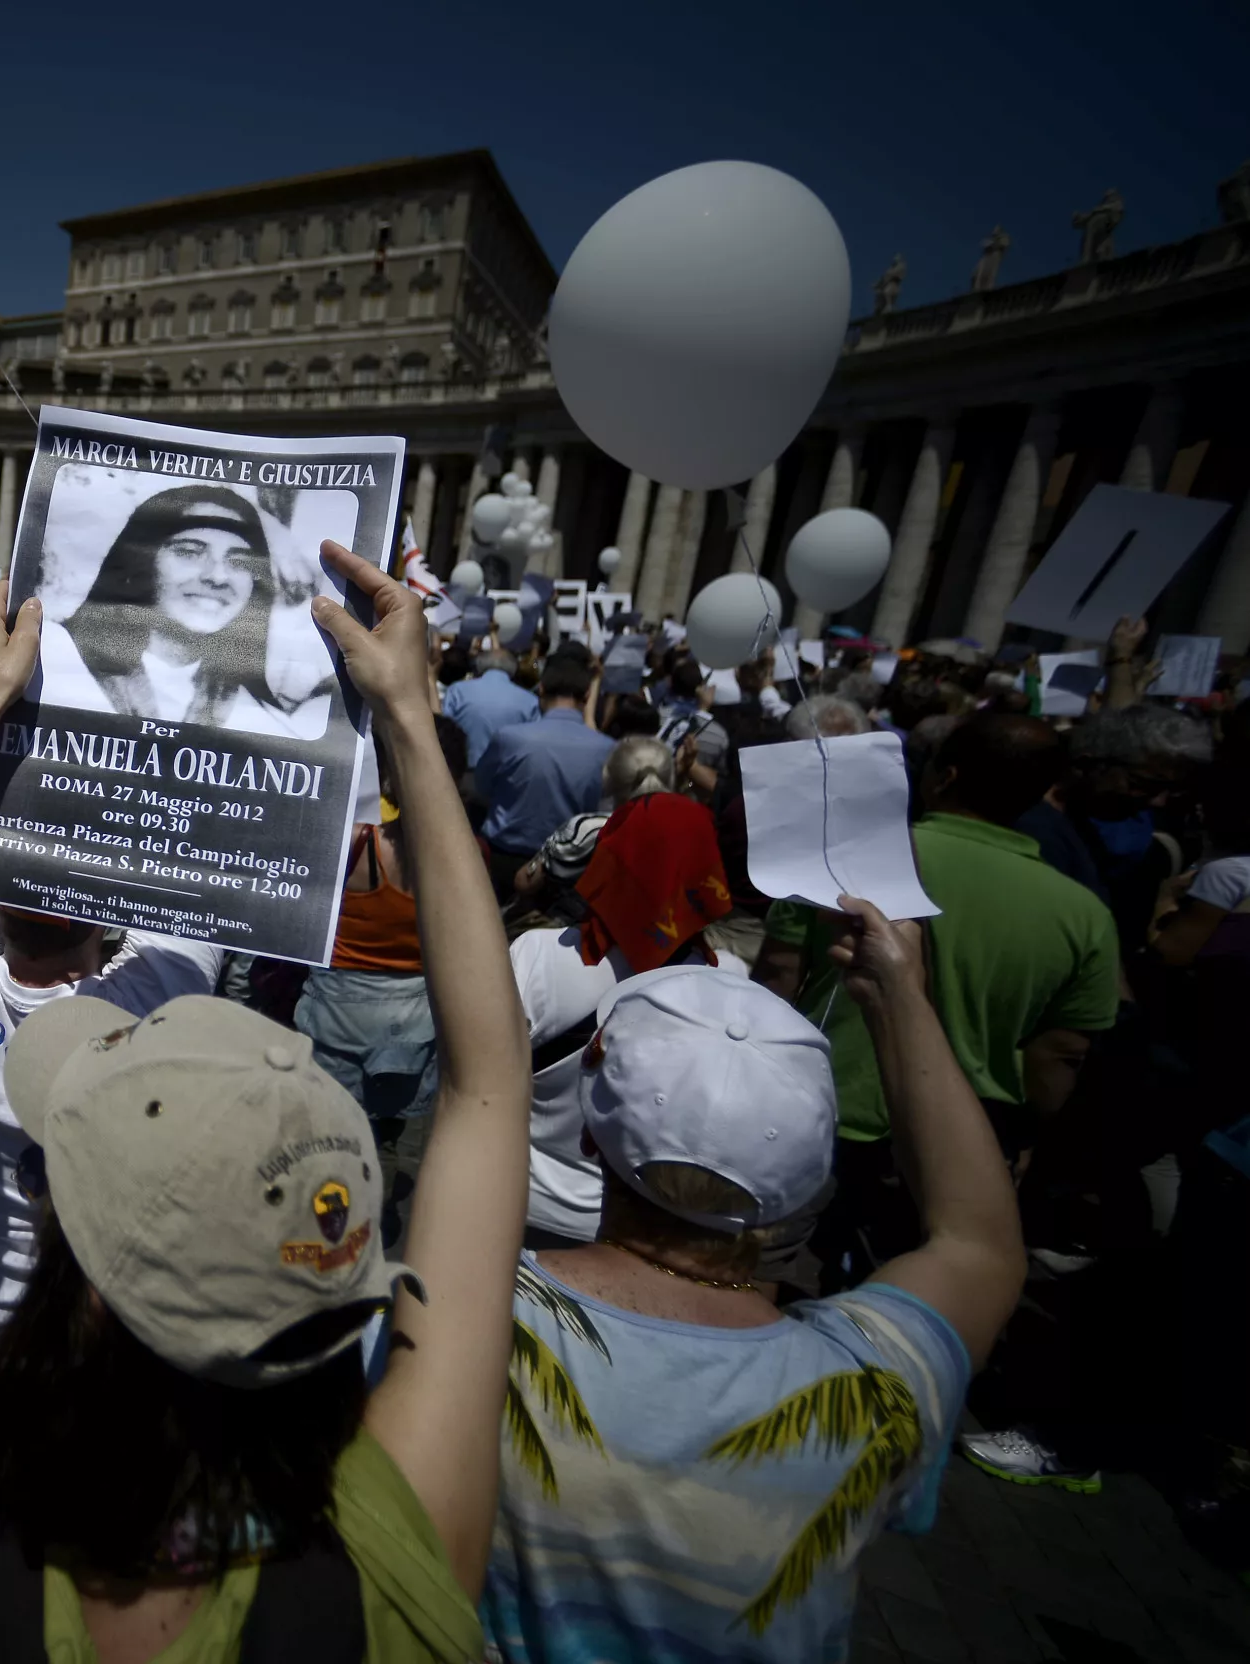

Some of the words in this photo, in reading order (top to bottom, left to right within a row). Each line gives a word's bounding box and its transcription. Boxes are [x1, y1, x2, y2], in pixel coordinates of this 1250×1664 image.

[50, 435, 139, 469] MARCIA
[148, 450, 233, 479] VERITA'
[239, 461, 253, 481] E
[258, 462, 377, 486] GIUSTIZIA
[139, 720, 179, 738] Per
[40, 773, 105, 798] ROMA
[111, 784, 134, 801] 27
[138, 789, 213, 817] Maggio
[218, 801, 264, 822] 2012
[173, 747, 325, 800] ORLANDI
[102, 810, 135, 825] ore
[139, 812, 190, 834] 09.30
[52, 843, 112, 870] Piazza
[119, 855, 134, 871] S.
[140, 858, 202, 882] Pietro
[208, 873, 243, 889] ore
[251, 877, 301, 899] 12,00
[72, 823, 133, 849] Piazza
[139, 835, 170, 854] del
[176, 841, 310, 878] Campidoglio
[41, 896, 49, 907] il
[51, 900, 78, 915] sole,
[81, 904, 92, 916] la
[107, 896, 117, 907] ti
[119, 897, 158, 914] hanno
[160, 907, 203, 922] negato
[205, 913, 215, 925] il
[217, 918, 253, 933] mare,
